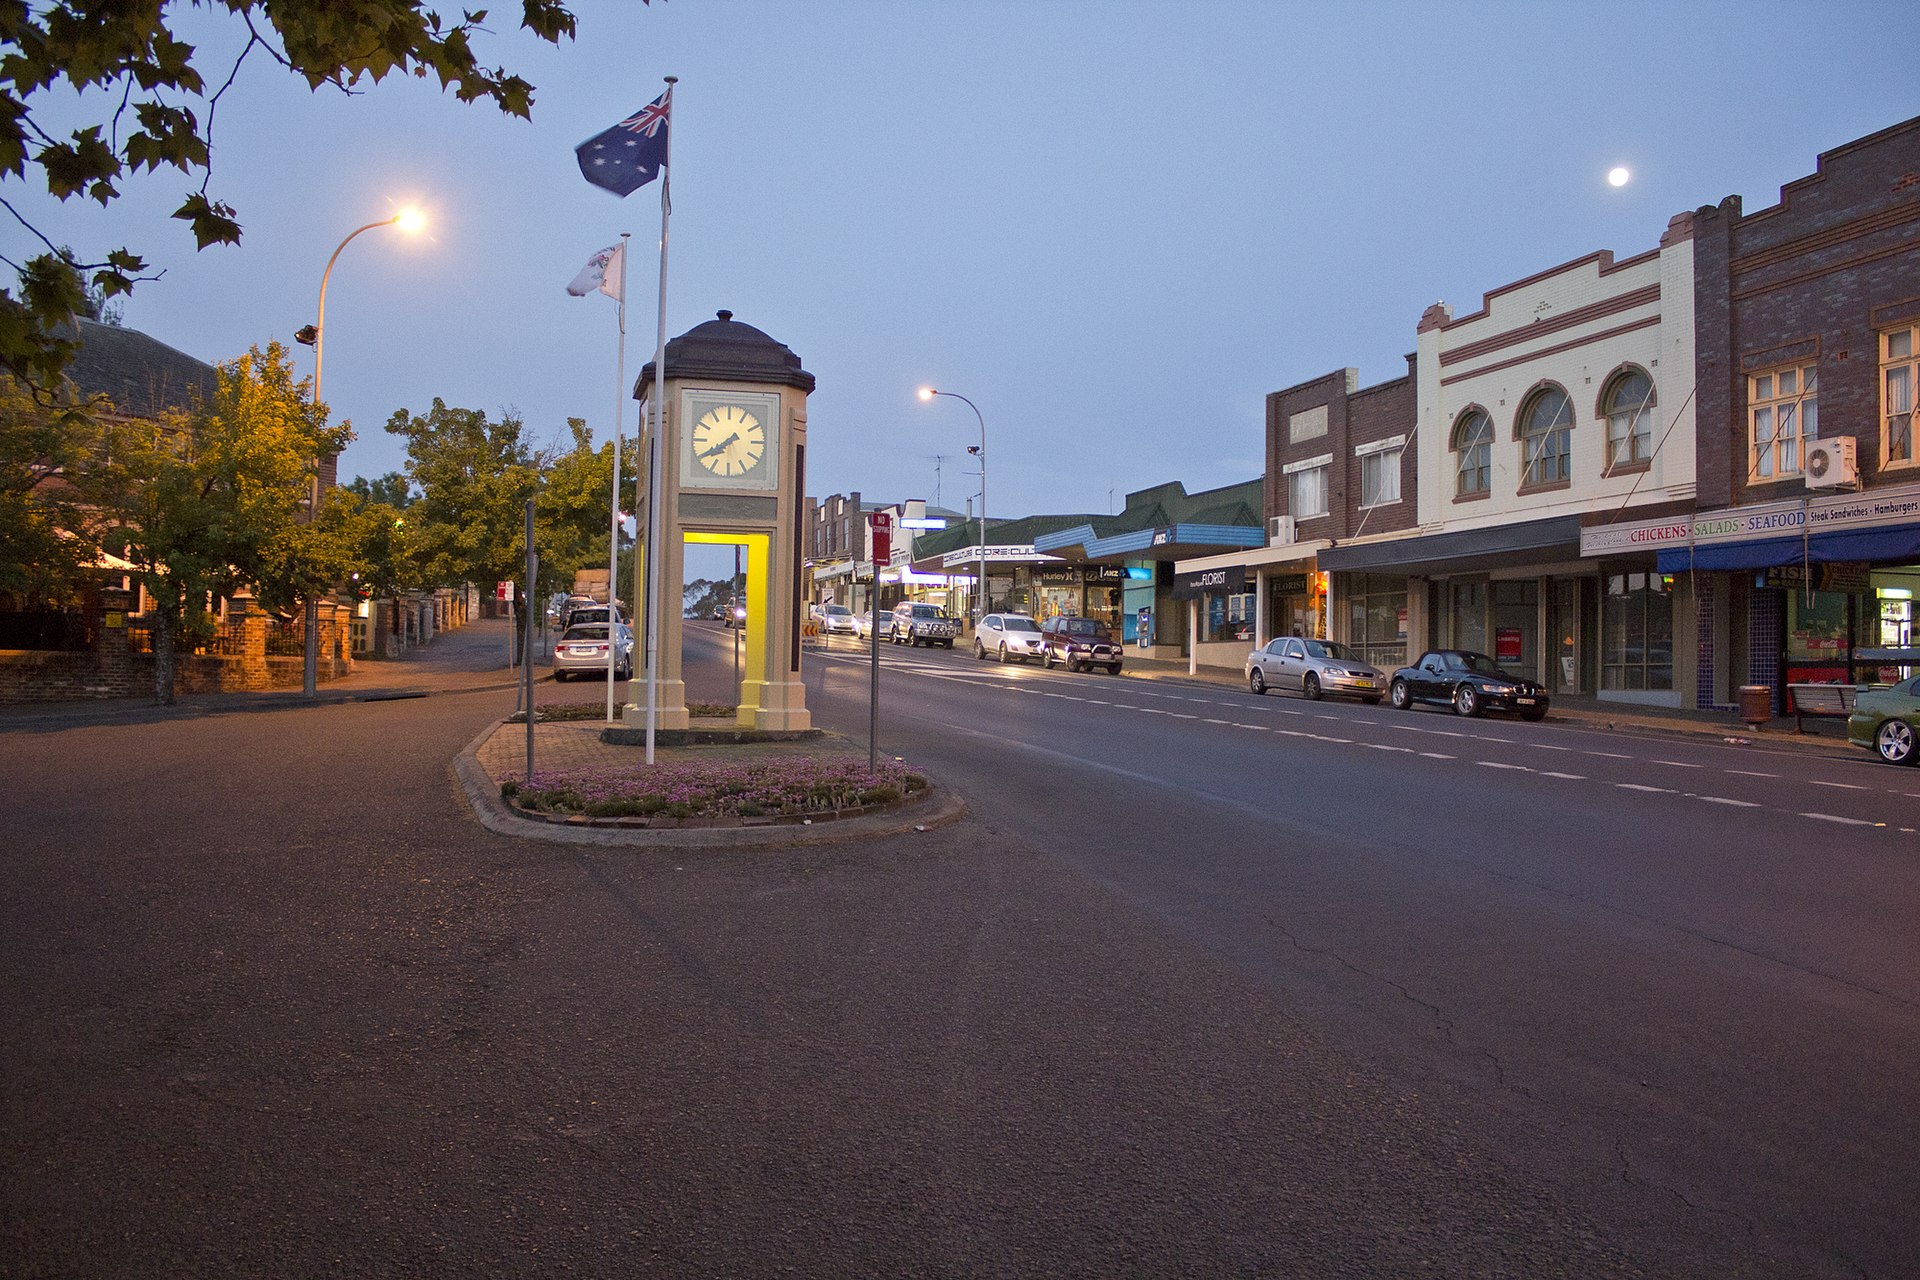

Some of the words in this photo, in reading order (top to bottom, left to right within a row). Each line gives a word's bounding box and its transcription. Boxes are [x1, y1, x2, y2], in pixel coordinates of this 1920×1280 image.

[1810, 510, 1829, 522] Steak
[1830, 506, 1868, 520] Sandwiches
[1874, 501, 1919, 515] Hamburgers
[877, 515, 886, 525] NO
[1630, 524, 1687, 543] CHICKENS
[1694, 519, 1739, 536] SALADS
[1748, 512, 1806, 530] SEAFOOD
[1153, 533, 1167, 545] ANZ
[1042, 572, 1066, 581] Hurley
[1202, 571, 1226, 586] FLORIST
[1768, 565, 1813, 580] FISH
